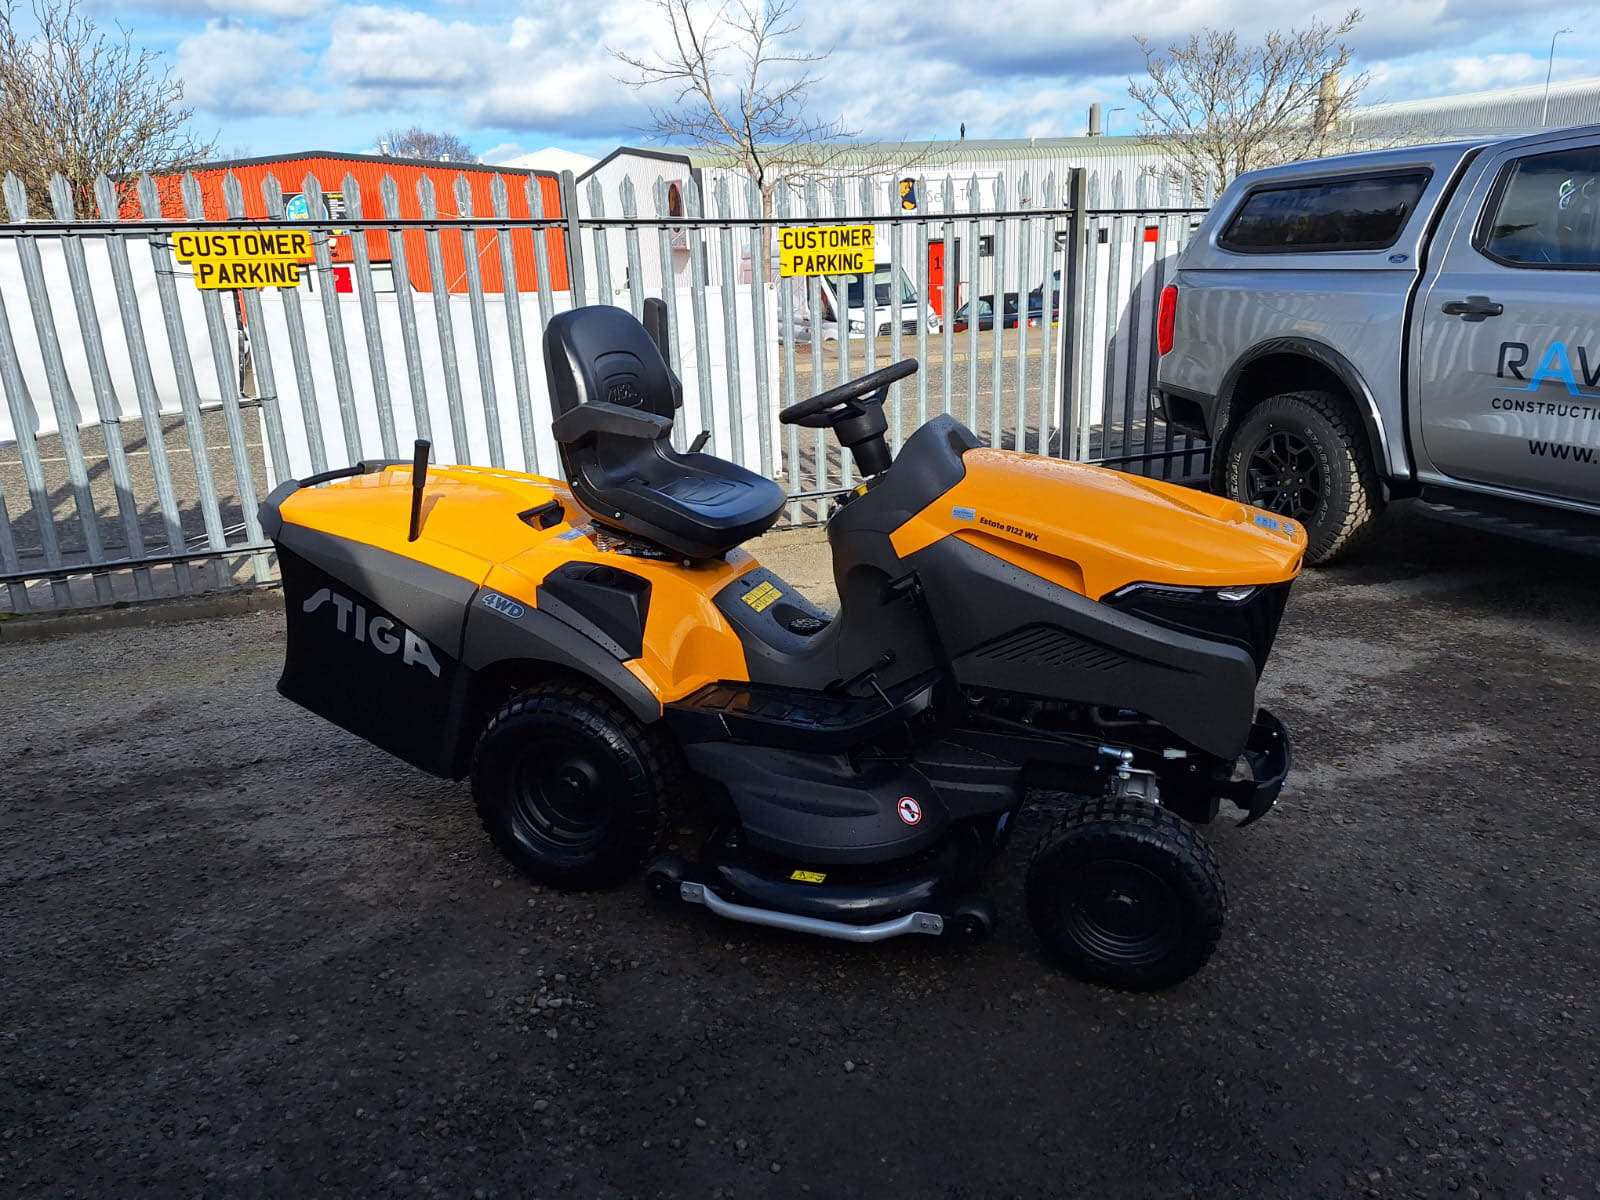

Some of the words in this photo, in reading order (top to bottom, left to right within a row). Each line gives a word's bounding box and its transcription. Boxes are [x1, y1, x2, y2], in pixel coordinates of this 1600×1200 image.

[178, 234, 306, 257] CUSTOMER
[783, 229, 871, 249] CUSTOMER
[199, 262, 300, 284] PARKING
[793, 253, 863, 273] PARKING
[1491, 398, 1600, 420] CONSTRUCTI
[980, 517, 1005, 530] Estate
[1006, 525, 1024, 536] 9122
[1024, 531, 1040, 542] WX
[484, 595, 523, 617] 4WD
[303, 588, 441, 678] STIGA
